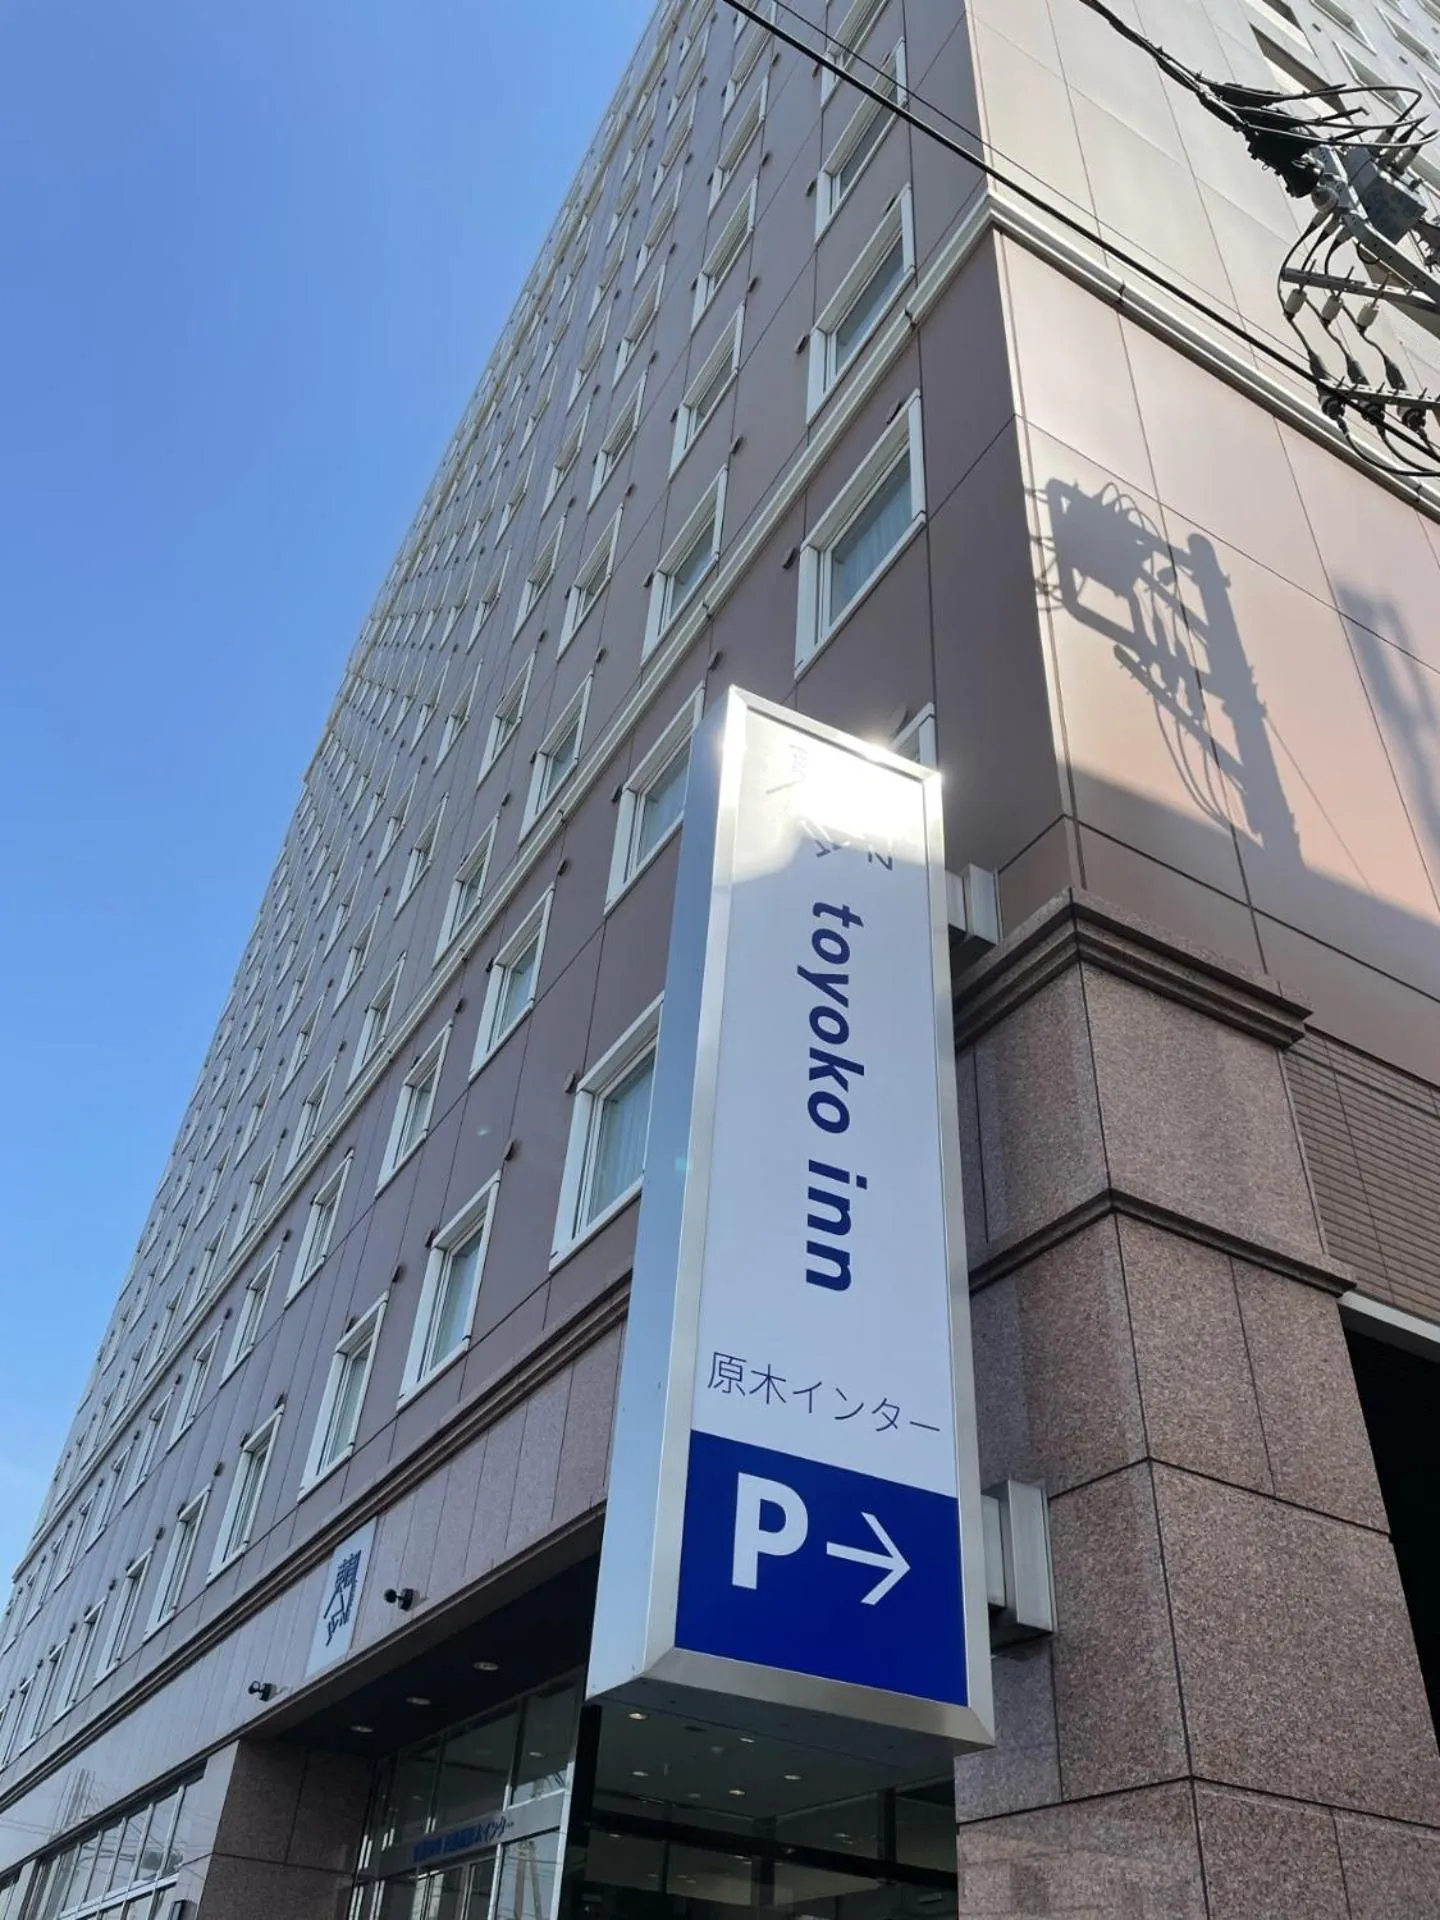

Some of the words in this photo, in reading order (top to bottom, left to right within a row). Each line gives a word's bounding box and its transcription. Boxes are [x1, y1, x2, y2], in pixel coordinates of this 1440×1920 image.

[797, 902, 865, 1134] toyoko
[806, 1159, 868, 1291] inn
[707, 1351, 941, 1433] 原木インター
[732, 1472, 809, 1590] P
